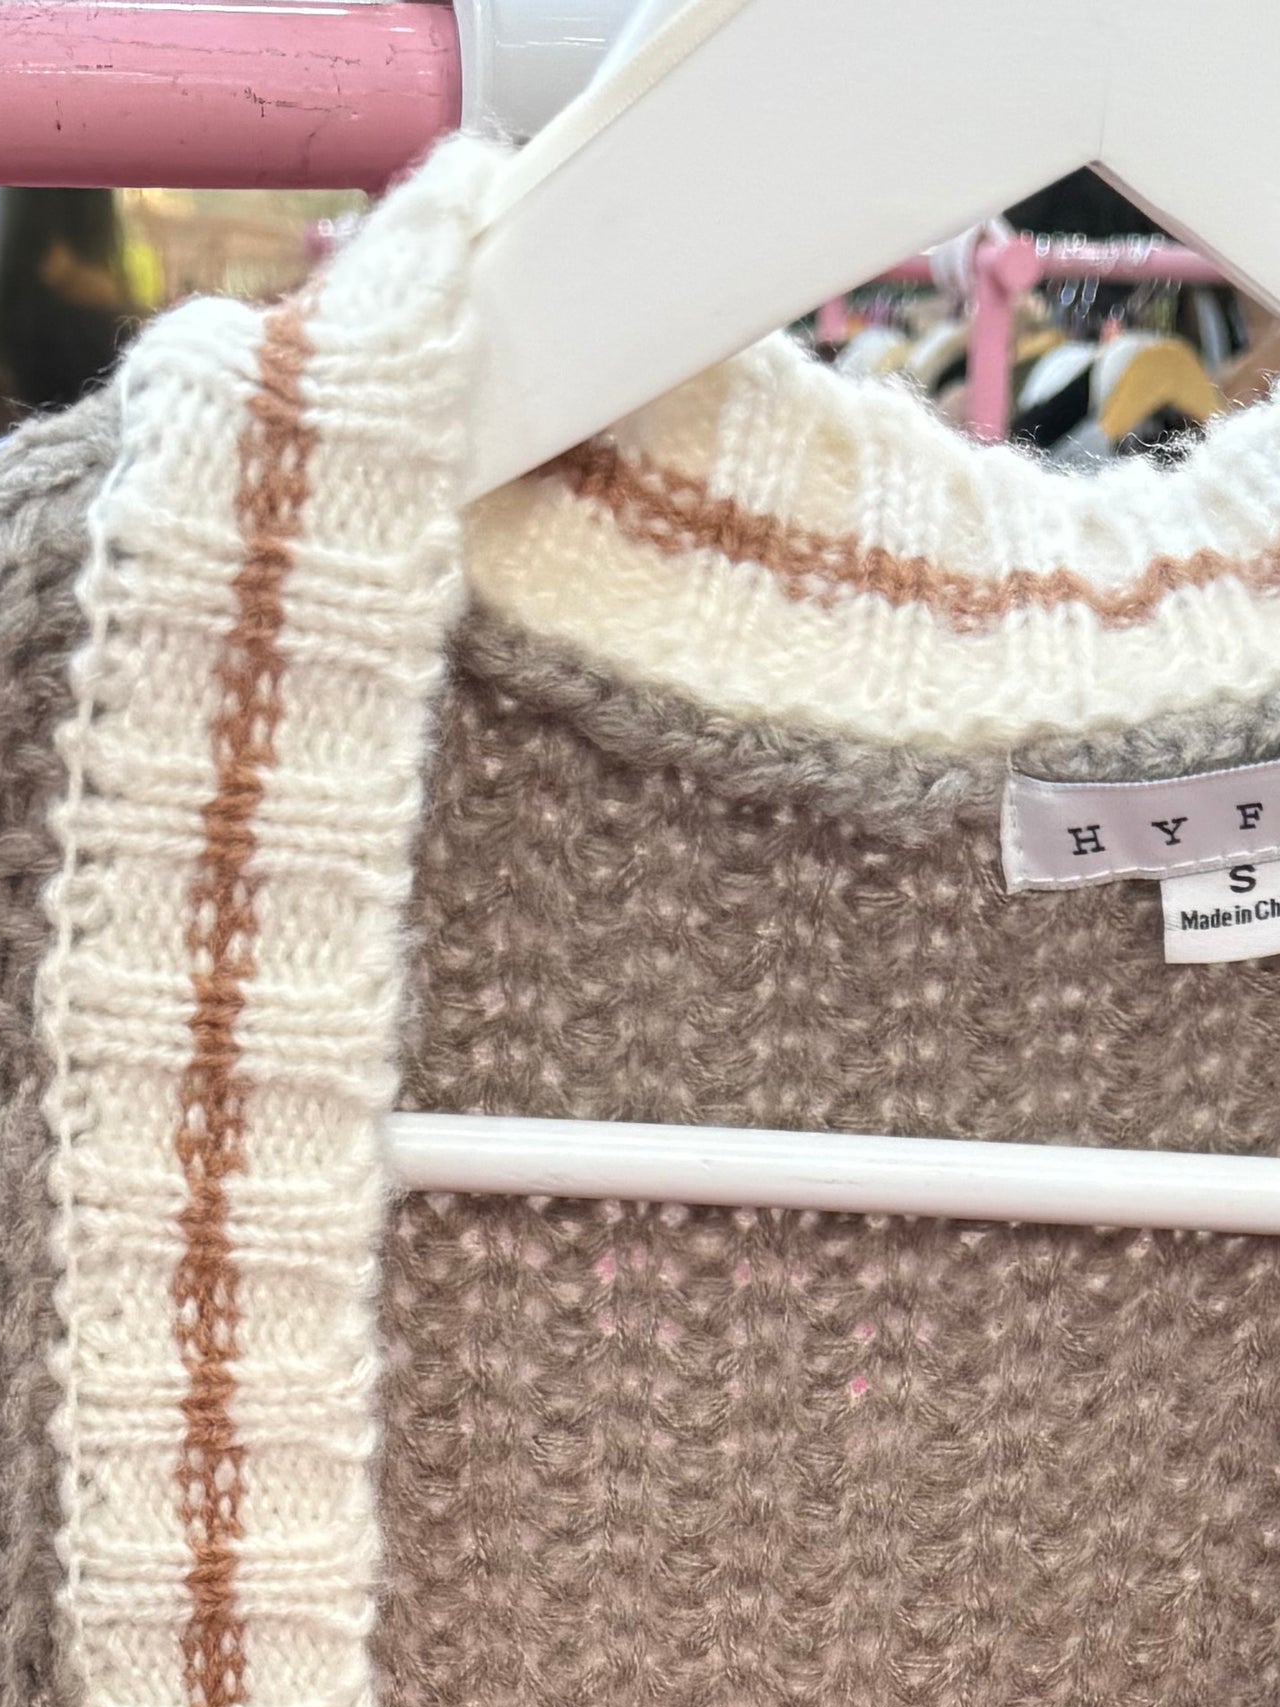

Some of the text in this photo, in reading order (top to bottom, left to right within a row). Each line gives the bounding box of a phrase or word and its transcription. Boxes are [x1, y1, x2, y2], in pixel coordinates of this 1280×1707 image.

[1228, 863, 1257, 893] S
[1180, 908, 1233, 931] Made
[1234, 904, 1252, 925] in
